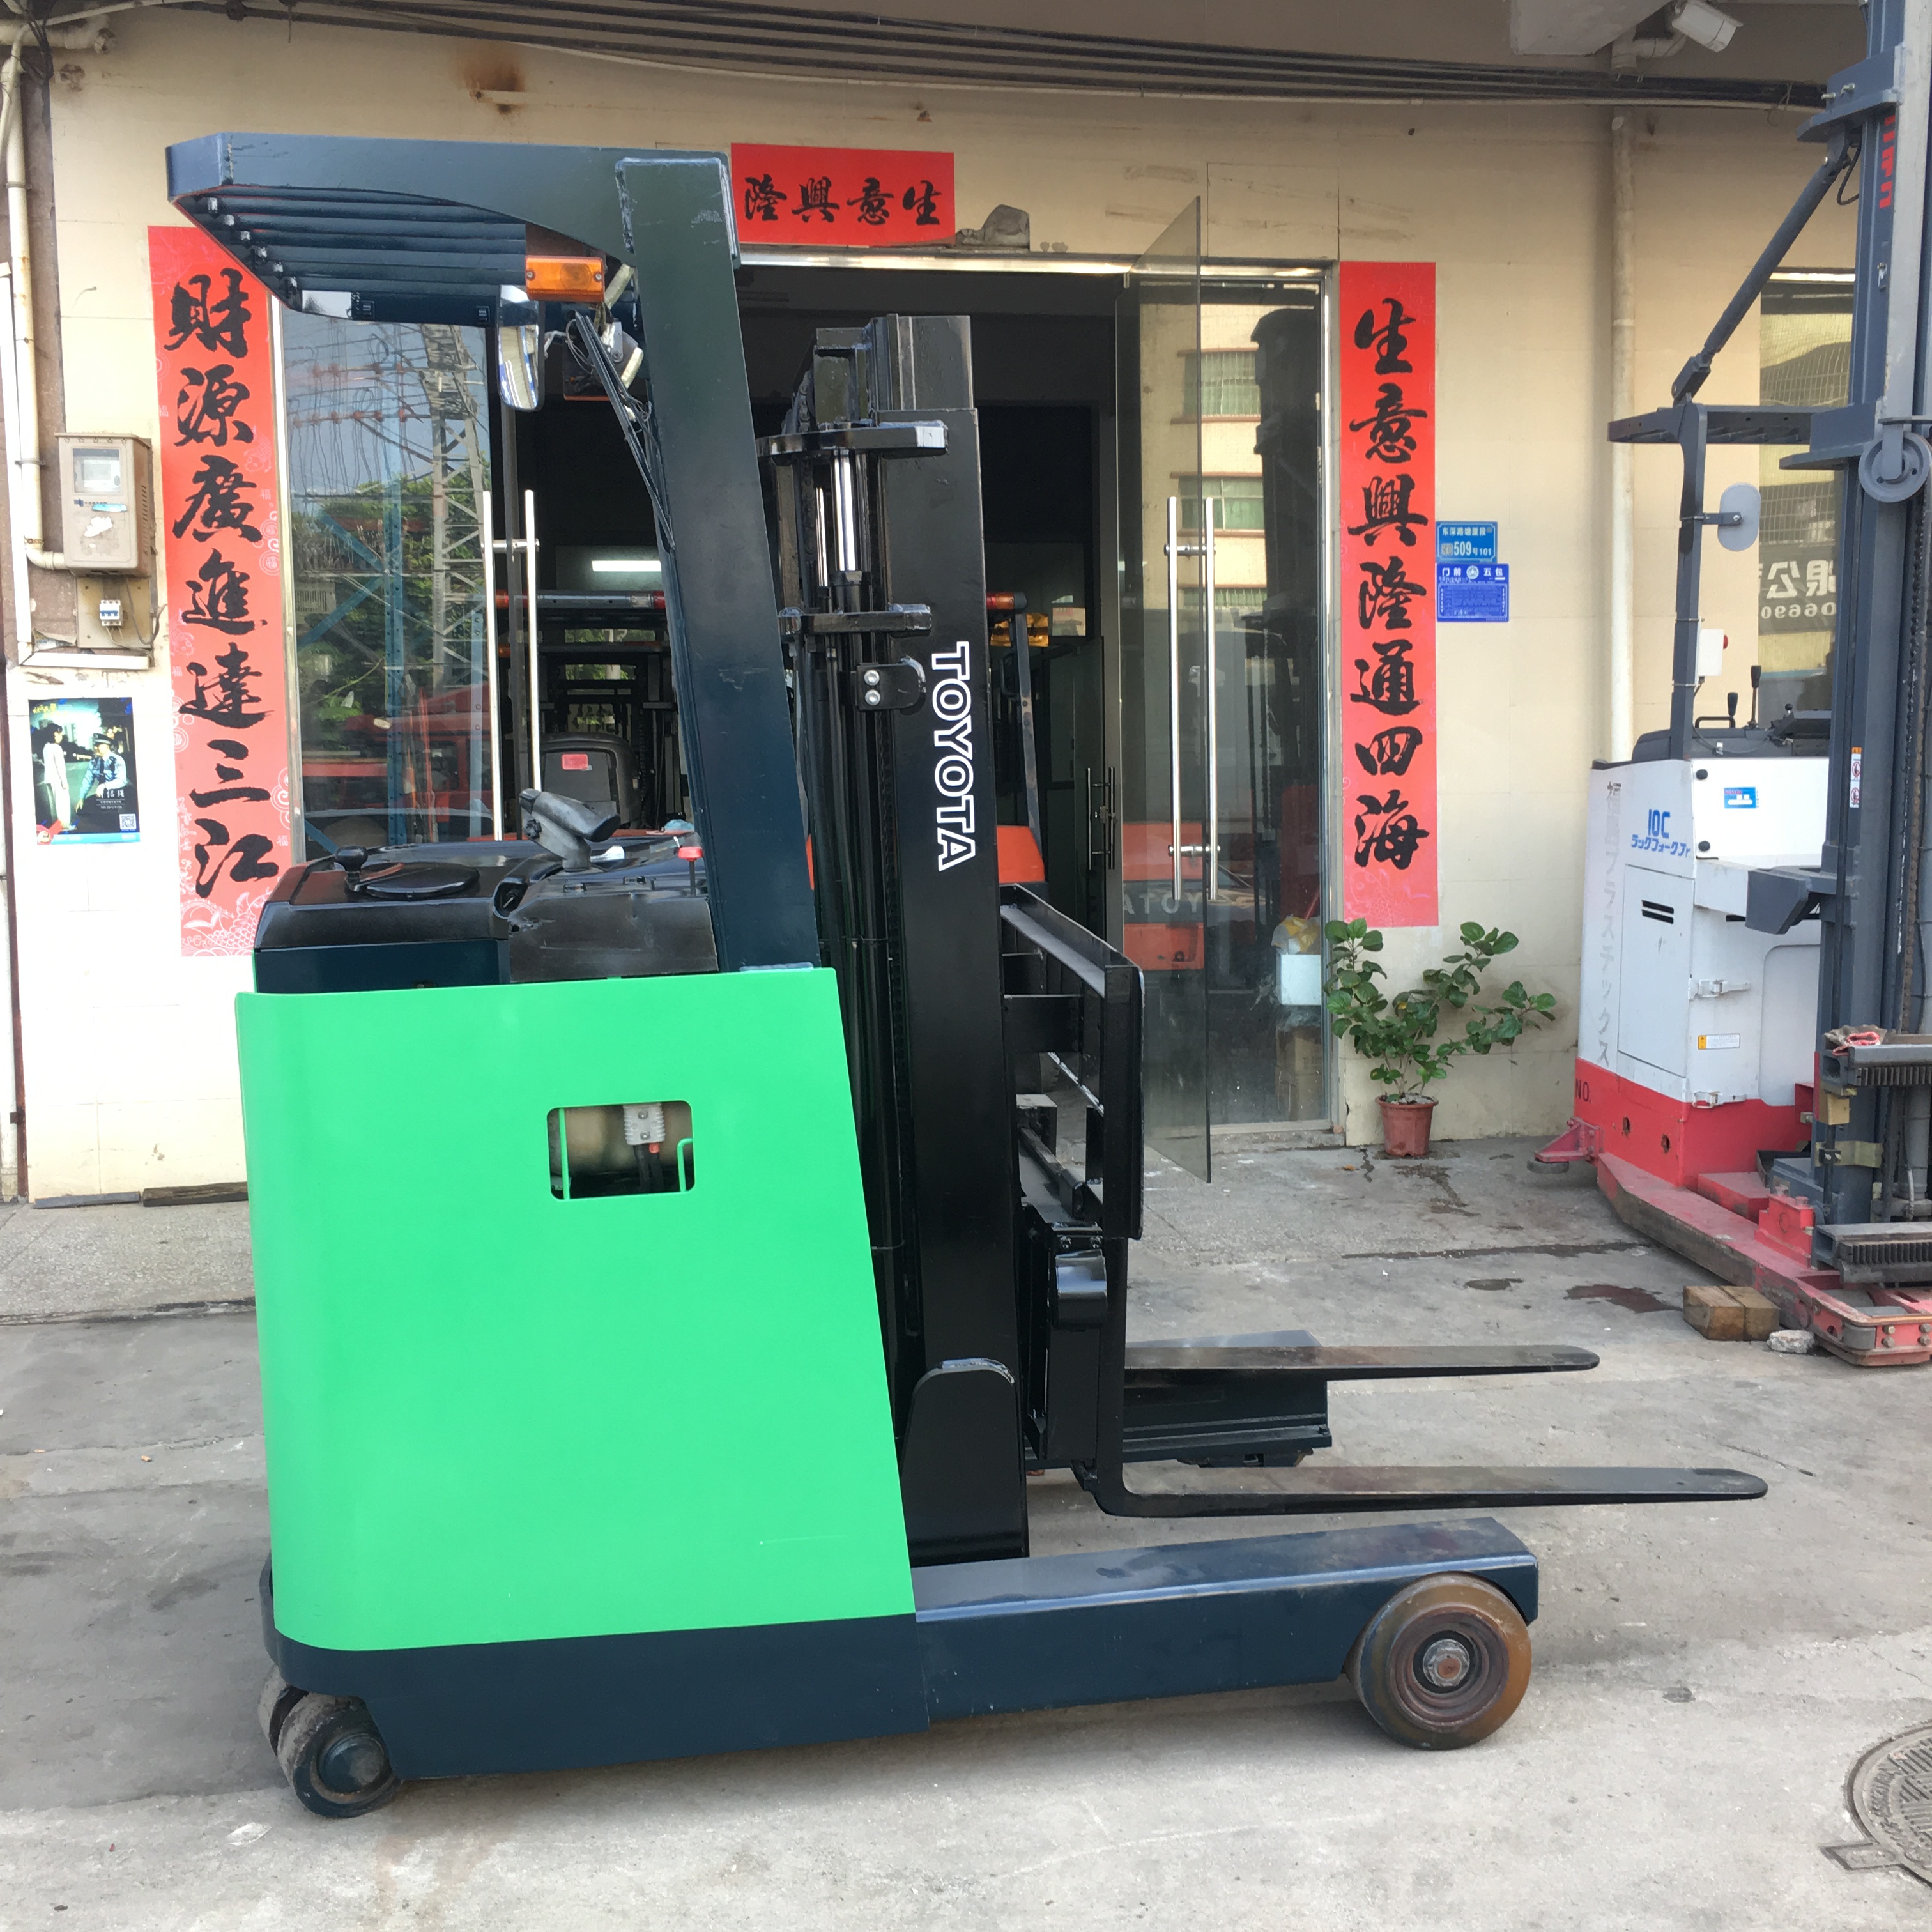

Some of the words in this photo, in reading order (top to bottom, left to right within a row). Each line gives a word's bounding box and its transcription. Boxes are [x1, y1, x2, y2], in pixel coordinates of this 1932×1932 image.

[164, 268, 279, 898] 財源廣進達三江
[931, 641, 976, 871] TOYOTA
[1347, 298, 1430, 870] 生意興隆通四海
